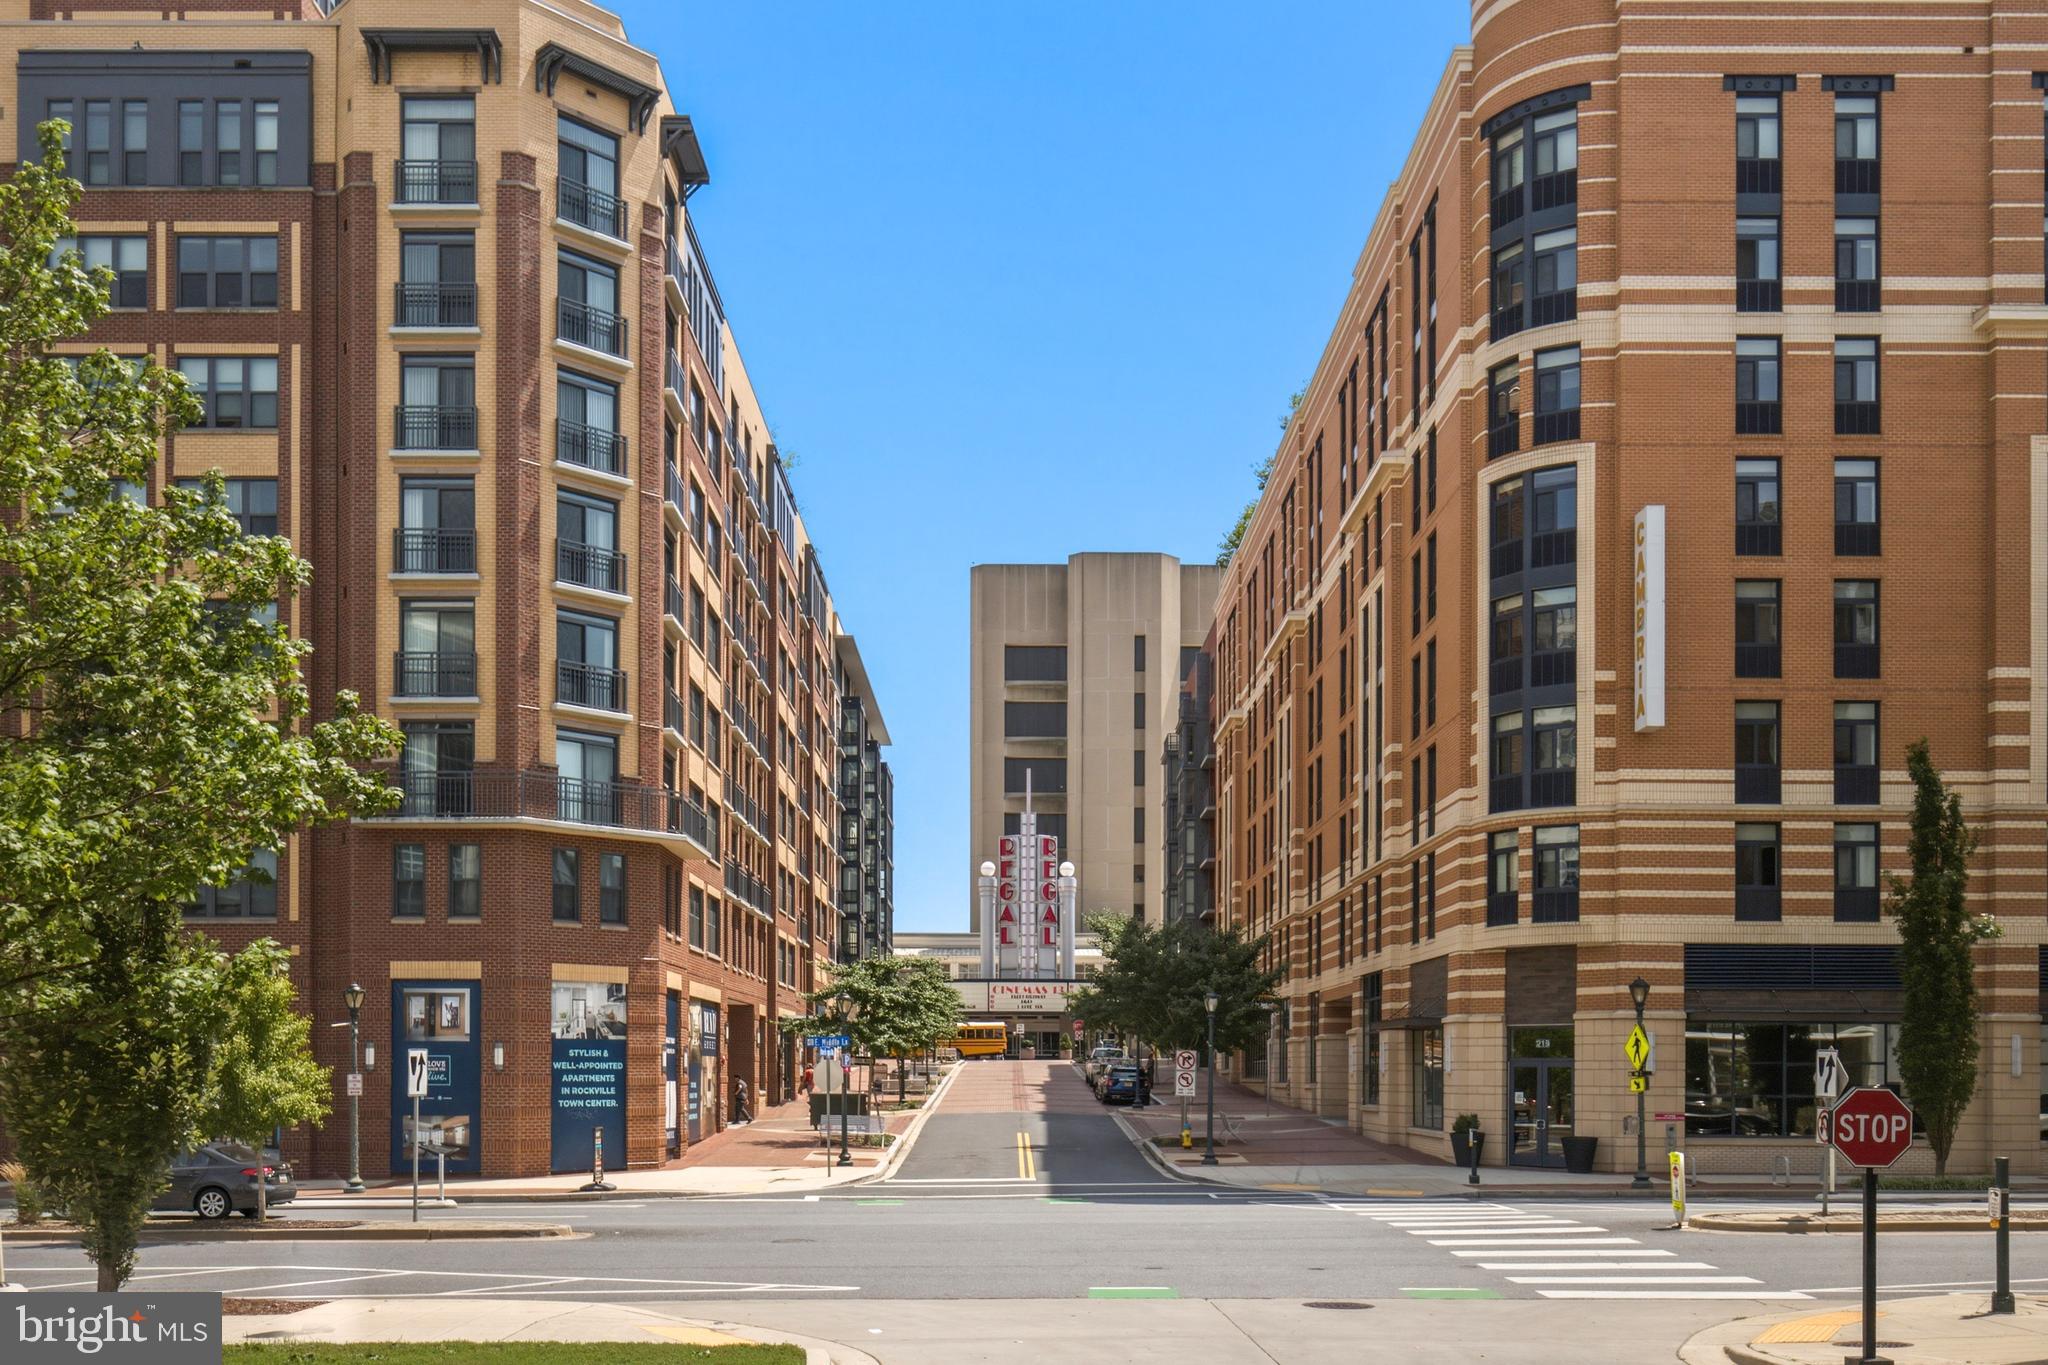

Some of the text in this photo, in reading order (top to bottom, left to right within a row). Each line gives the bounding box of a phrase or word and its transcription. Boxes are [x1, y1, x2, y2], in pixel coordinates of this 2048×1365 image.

[1000, 838, 1015, 945] REGAL
[1042, 837, 1057, 945] REGAL
[992, 985, 1048, 994] CINEMAS
[568, 1049, 609, 1057] STYLISH &
[552, 1061, 624, 1070] WELL-APPOINTED
[562, 1074, 616, 1082] APARTMENTS
[561, 1087, 616, 1095] IN ROCKVILLE
[558, 1099, 618, 1108] TOWN CENTER.
[1839, 1113, 1907, 1143] STOP
